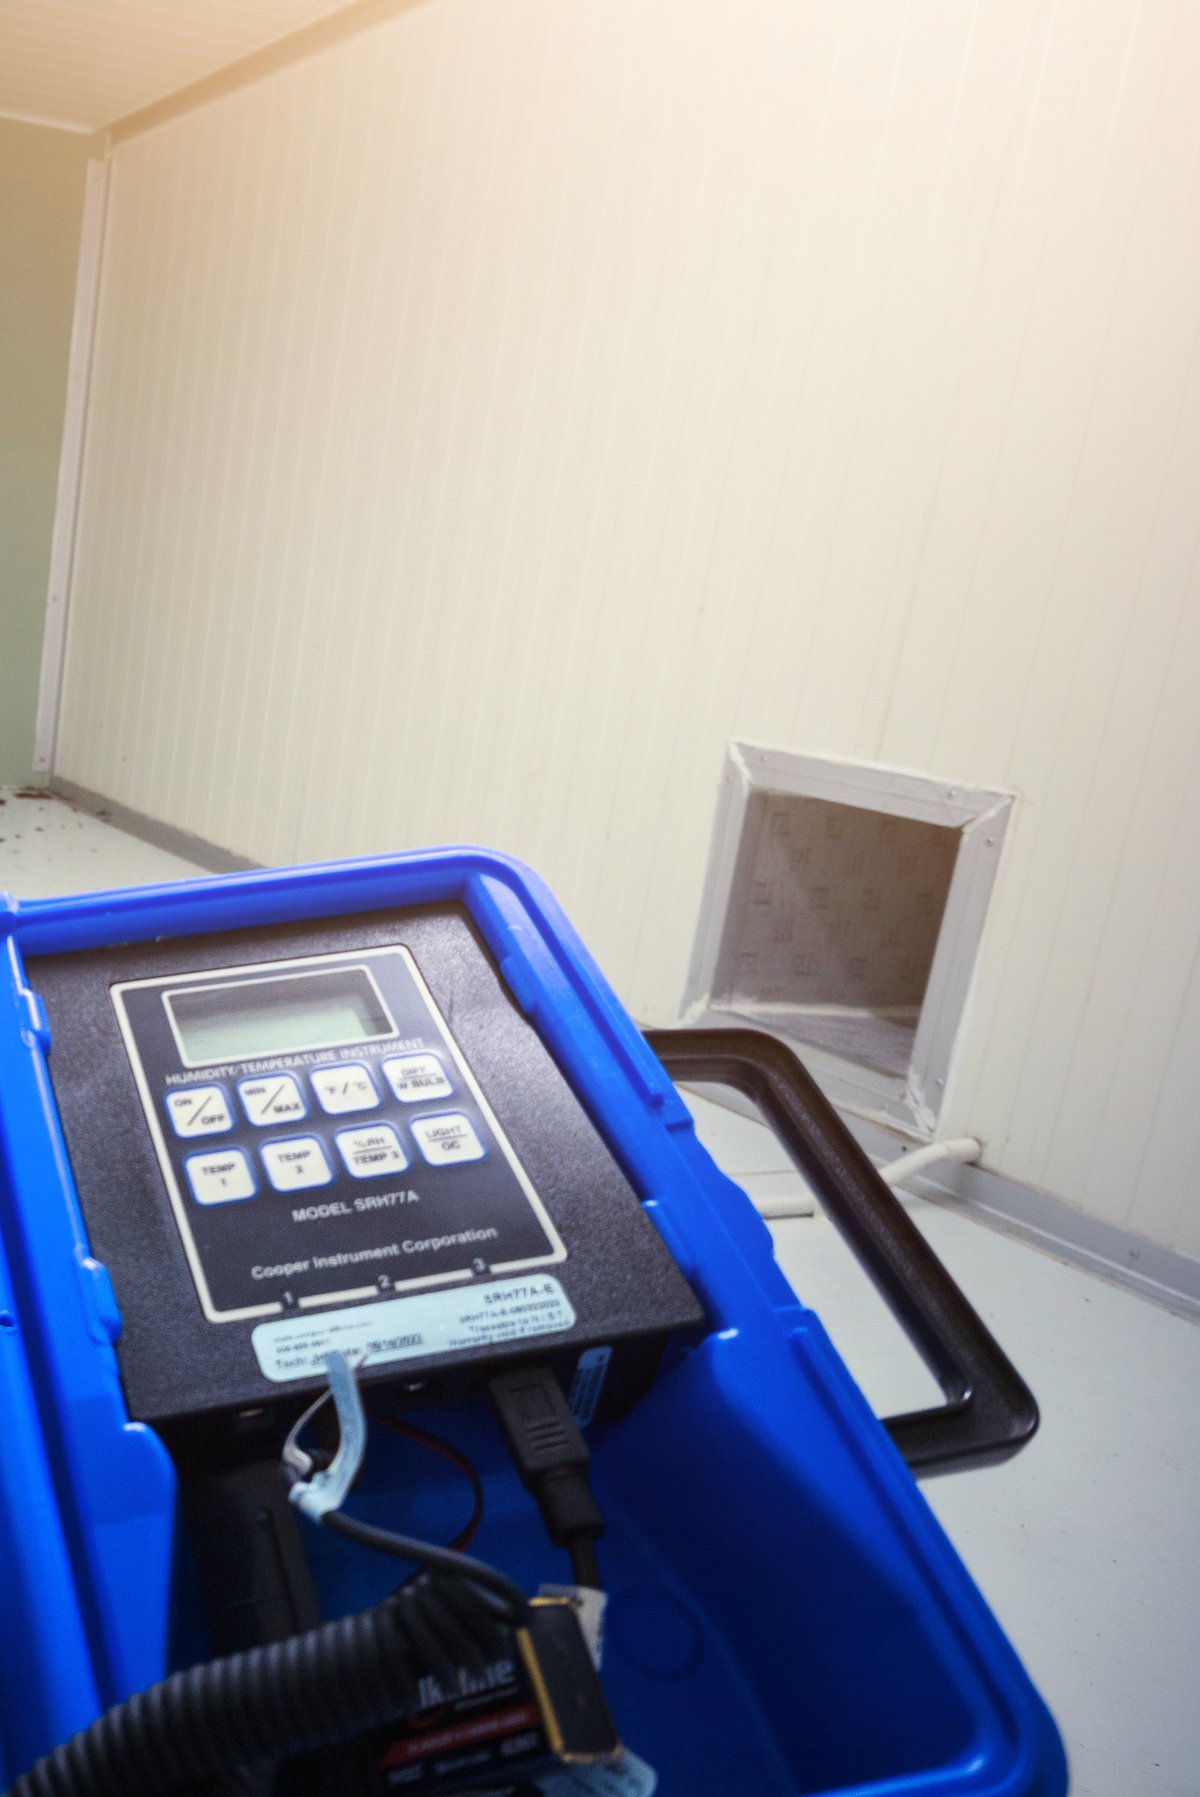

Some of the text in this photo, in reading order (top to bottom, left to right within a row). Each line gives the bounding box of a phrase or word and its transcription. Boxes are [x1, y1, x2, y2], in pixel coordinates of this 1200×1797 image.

[339, 1038, 425, 1060] INSTRUMENT
[412, 1075, 446, 1090] BULB
[245, 1086, 267, 1098] MIN
[174, 1096, 193, 1108] ON
[273, 1101, 302, 1116] MAX
[201, 1113, 226, 1126] OFF
[424, 1124, 463, 1138] LIGHT
[277, 1149, 312, 1164] TEMP
[353, 1152, 389, 1167] TEMP
[202, 1162, 237, 1177] TEMP
[291, 1189, 421, 1224] MODEL SRH77A
[250, 1226, 499, 1281] Cooper Instrument Corporation
[473, 1257, 486, 1272] 3
[378, 1274, 392, 1289] 2
[483, 1282, 556, 1305] SRH77A-E
